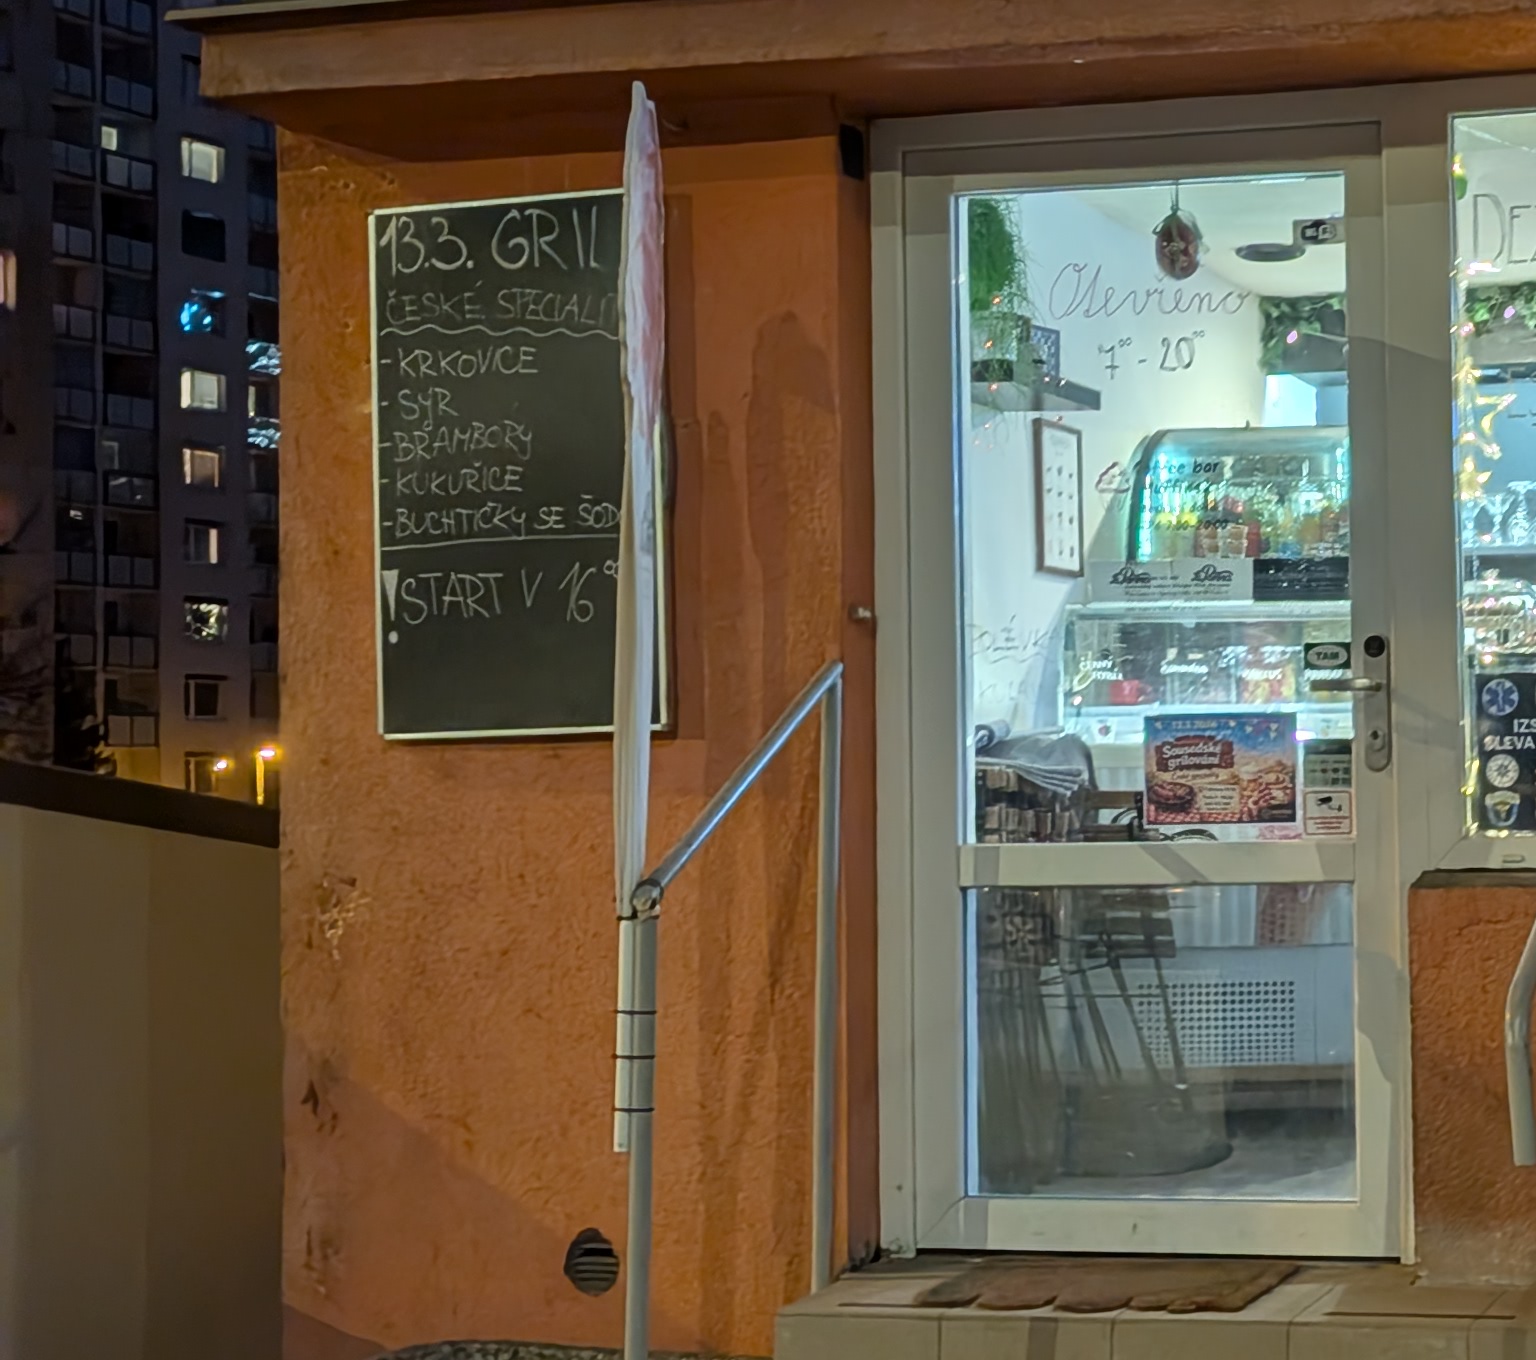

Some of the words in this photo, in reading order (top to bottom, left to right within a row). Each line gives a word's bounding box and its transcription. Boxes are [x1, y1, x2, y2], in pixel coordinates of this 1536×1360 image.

[379, 215, 475, 277] 13.3.
[385, 280, 486, 325] ČESKÉ
[1049, 261, 1252, 320] Otevřeno
[399, 346, 538, 377] KRKOVICE
[393, 419, 532, 462] BRAMBORY
[396, 460, 524, 495] KUKUŘICE
[533, 507, 566, 529] SE
[578, 495, 620, 528] ŠOD
[401, 572, 503, 625] START
